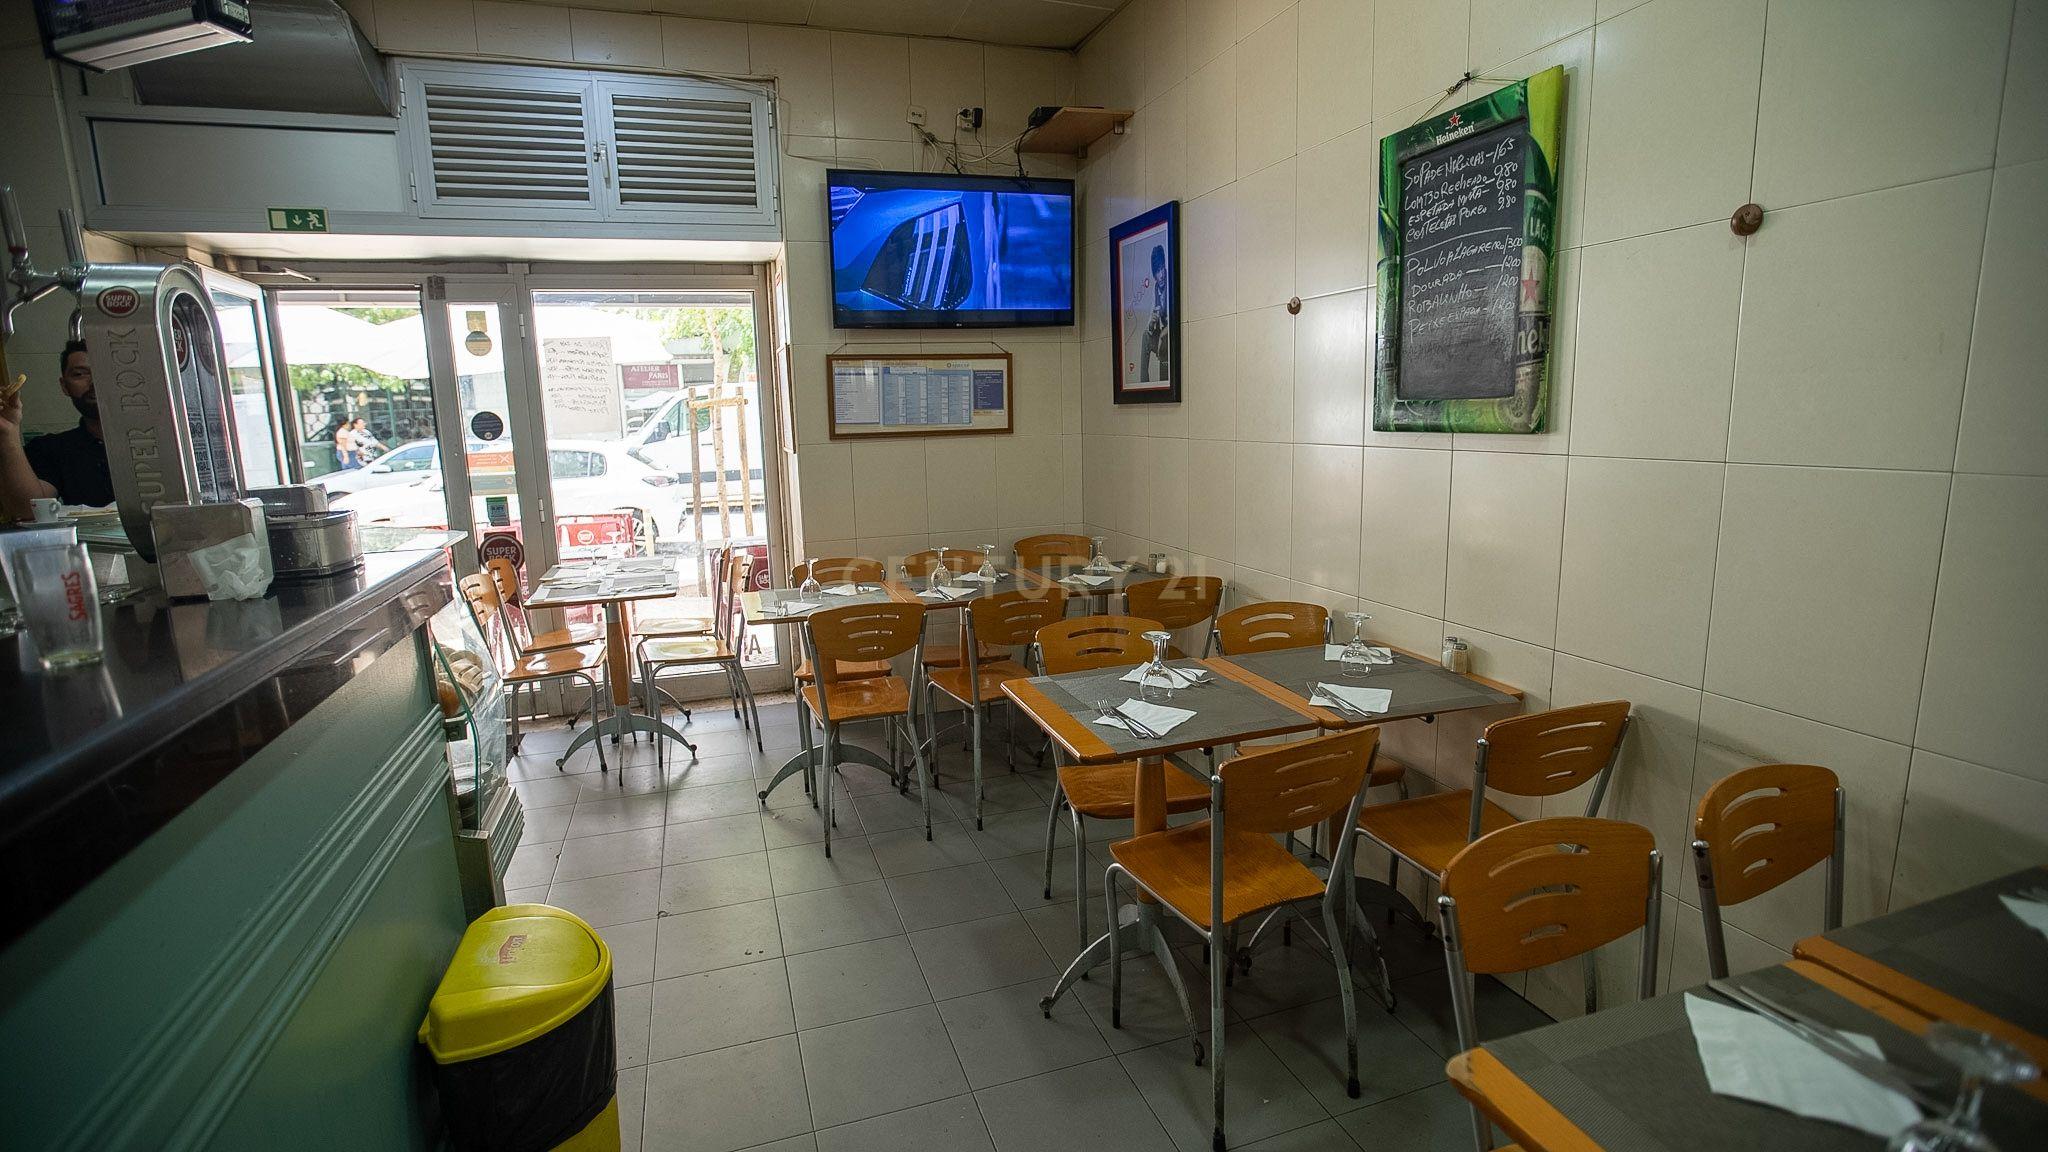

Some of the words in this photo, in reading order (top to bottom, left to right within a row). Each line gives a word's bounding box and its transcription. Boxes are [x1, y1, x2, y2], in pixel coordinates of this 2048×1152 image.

[1435, 125, 1475, 146] Heineken
[1411, 269, 1464, 298] DOURADA
[105, 294, 133, 302] SUPER
[106, 300, 132, 308] BOCK
[107, 326, 151, 412] BOCK
[486, 545, 517, 556] SUPER
[60, 571, 88, 621] SAGRES
